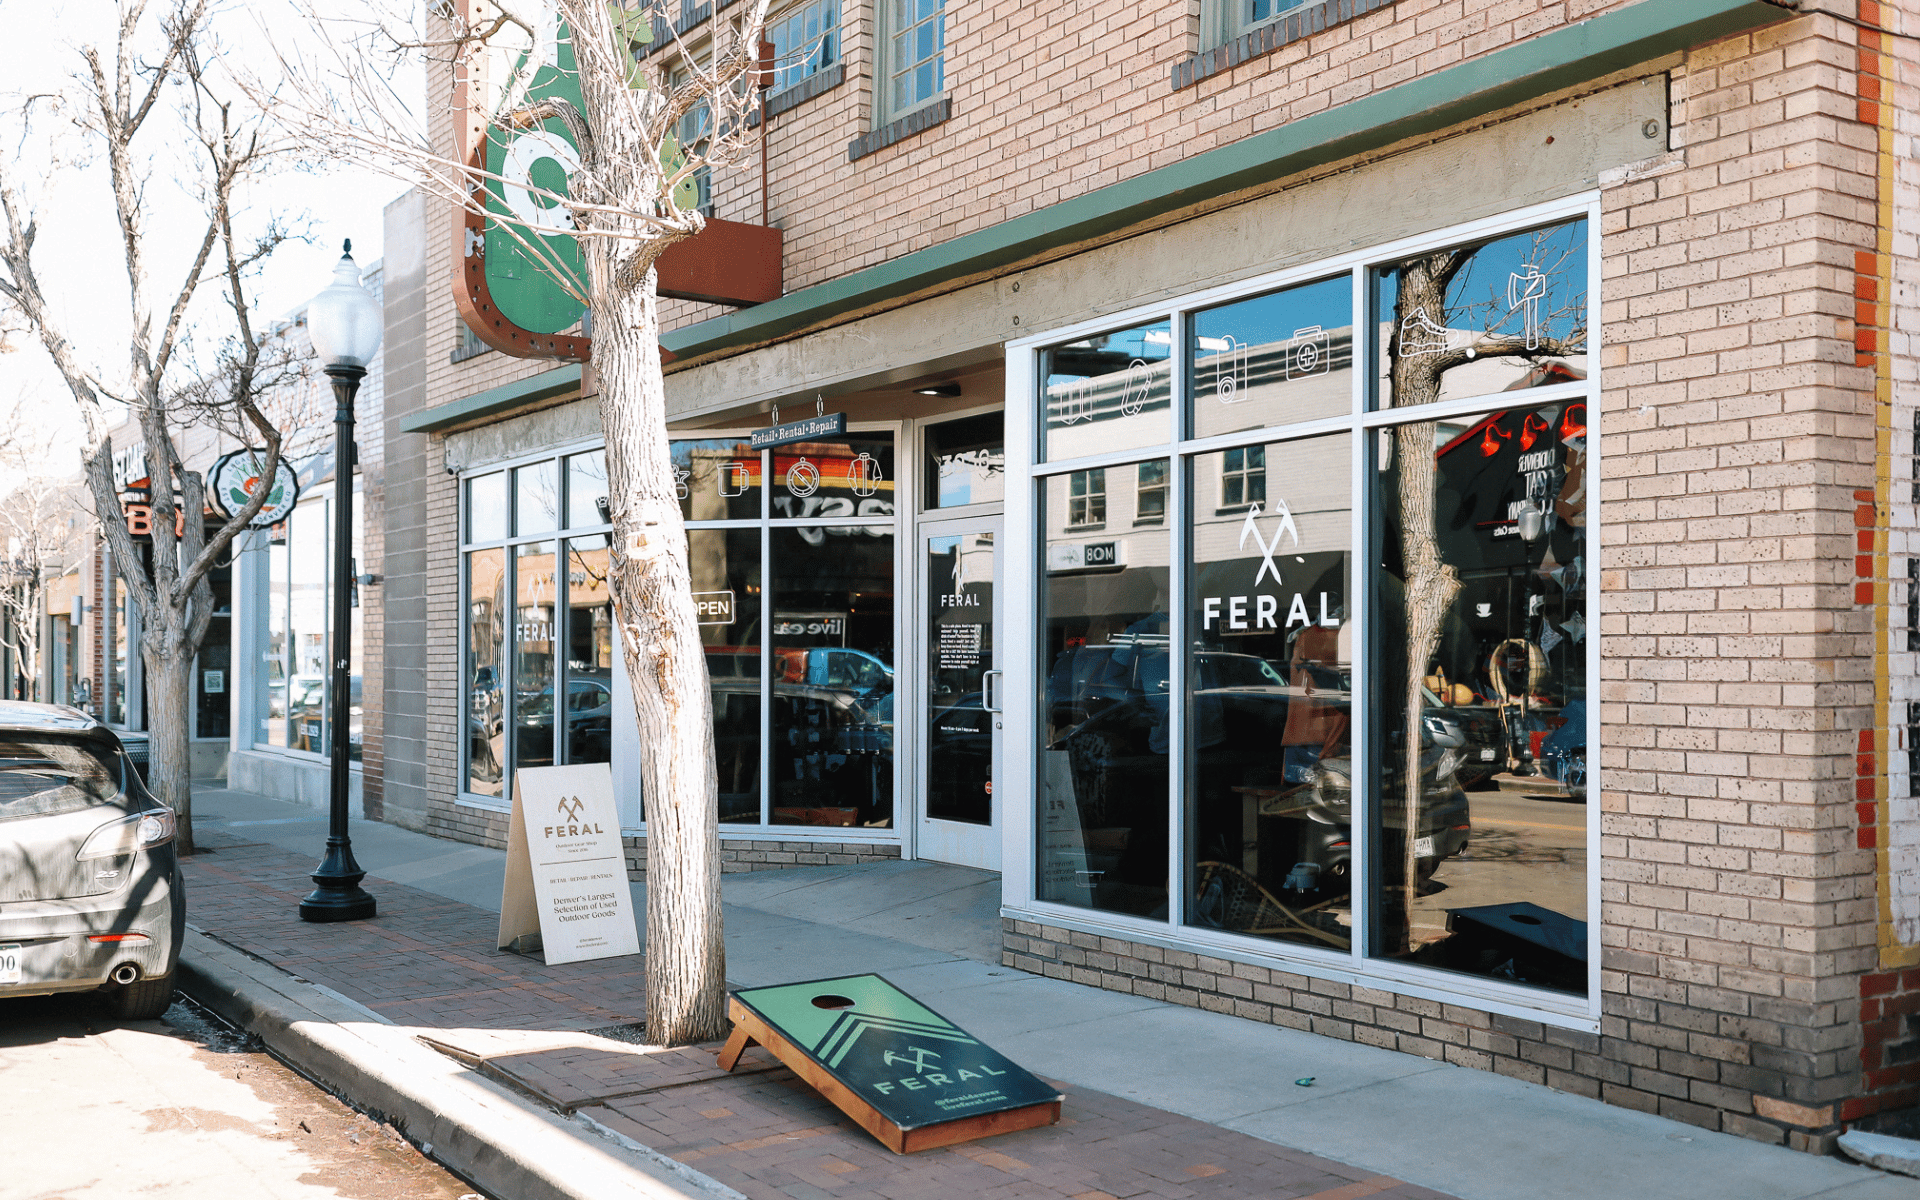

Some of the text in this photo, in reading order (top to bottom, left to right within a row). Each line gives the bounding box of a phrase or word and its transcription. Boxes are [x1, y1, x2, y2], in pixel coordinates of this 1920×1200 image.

[751, 418, 838, 445] Retail Rental Repair
[941, 593, 980, 608] FERAL
[1203, 591, 1340, 631] FERAL
[515, 622, 555, 642] FERAL
[544, 822, 604, 839] FERAL
[553, 892, 615, 905] Denver's Largest
[553, 900, 618, 914] Selection of Used
[558, 910, 616, 923] Outdoor Goods
[873, 1064, 1007, 1095] FERAL
[934, 1089, 1001, 1106] @feraldenver
[940, 1094, 1008, 1111] liveferal.com
